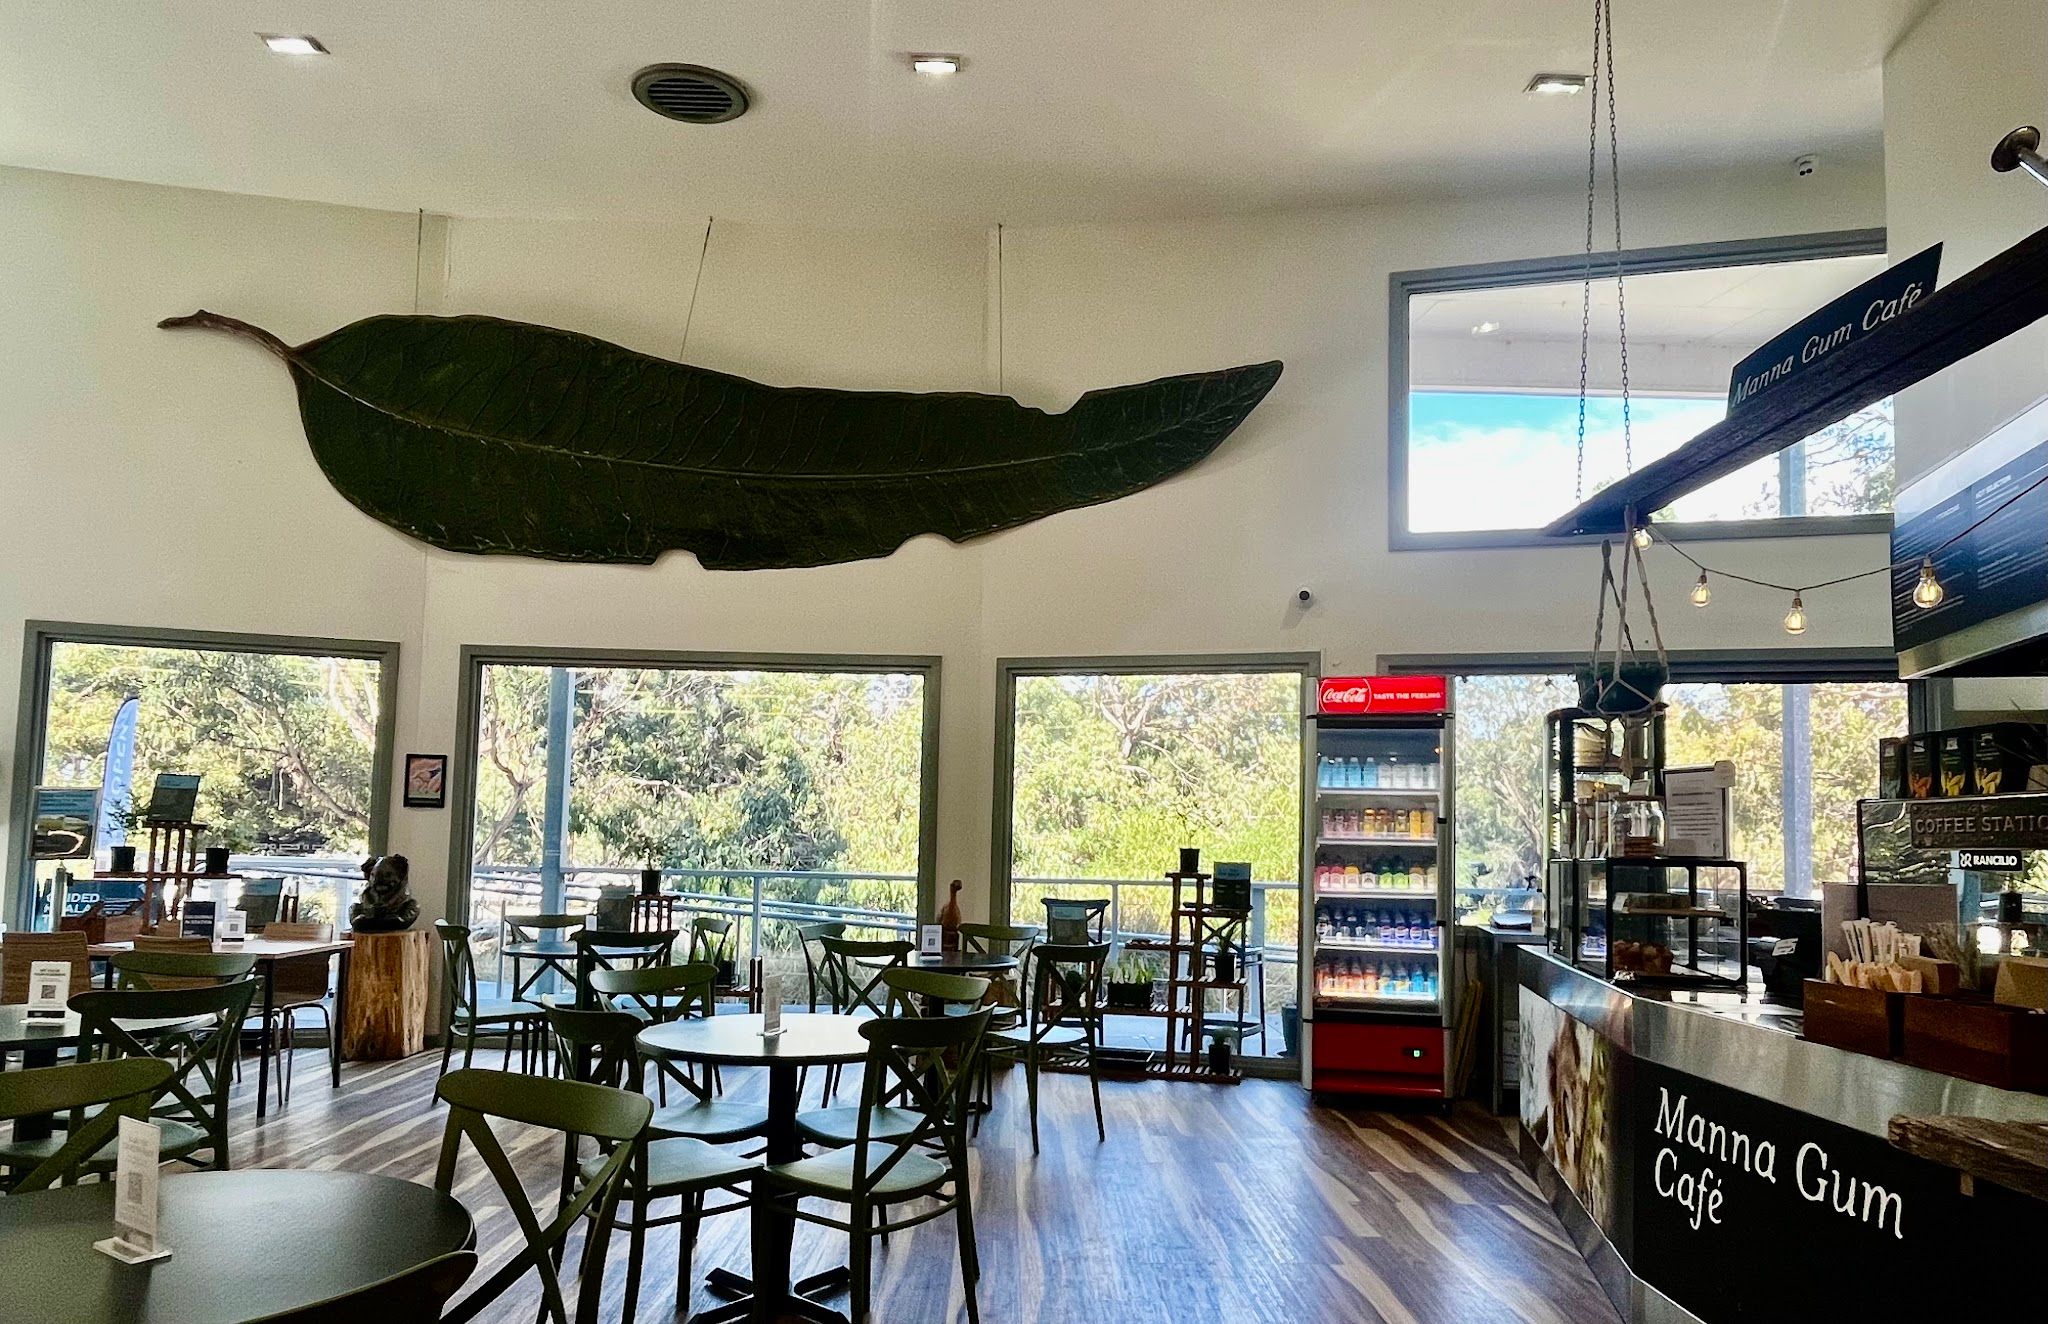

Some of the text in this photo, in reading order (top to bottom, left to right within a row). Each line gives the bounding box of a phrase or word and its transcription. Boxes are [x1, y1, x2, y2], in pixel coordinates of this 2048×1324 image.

[1732, 282, 1924, 407] Manna Gum Café
[1373, 692, 1395, 700] TASTE
[1396, 692, 1410, 700] THE
[111, 719, 130, 796] OPEN
[1915, 817, 1976, 833] COFFEE
[1973, 855, 2018, 866] RANCILIO
[46, 893, 101, 903] IDED
[1654, 1086, 1903, 1240] Manna Gum
[1654, 1147, 1724, 1230] Café
